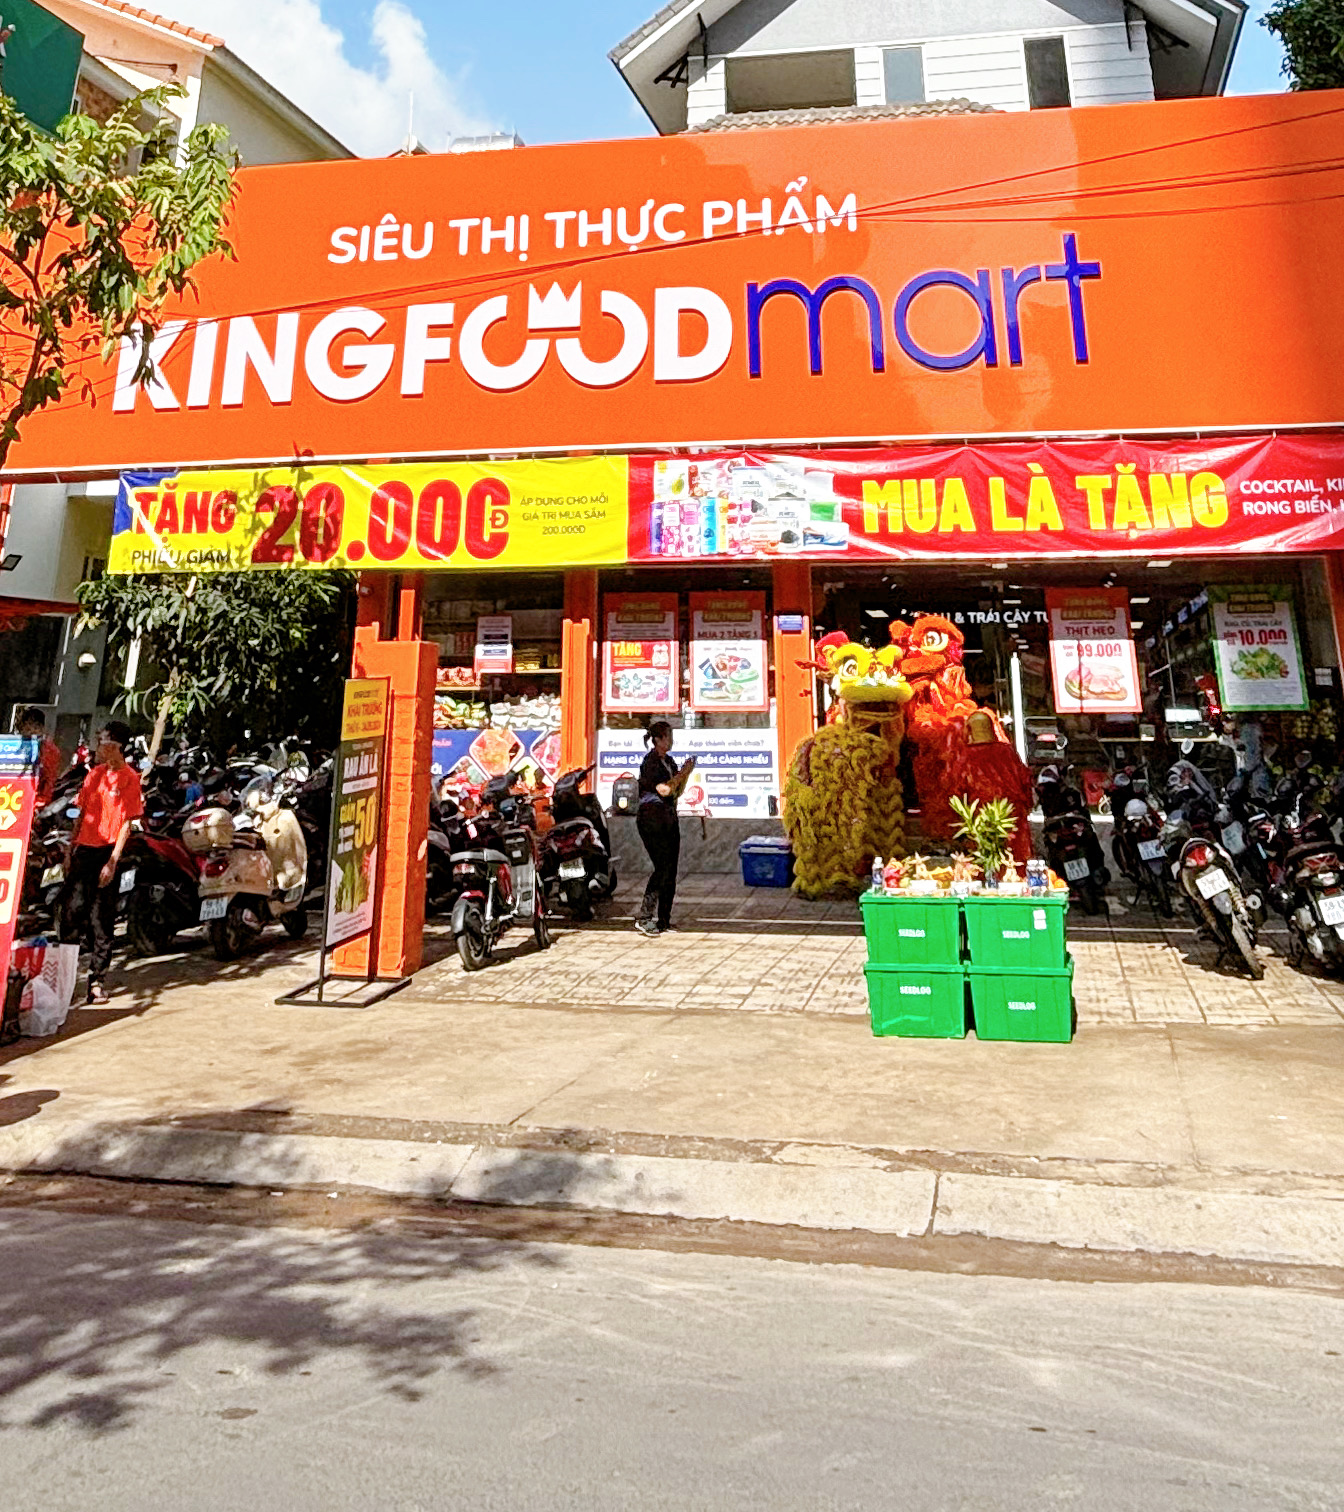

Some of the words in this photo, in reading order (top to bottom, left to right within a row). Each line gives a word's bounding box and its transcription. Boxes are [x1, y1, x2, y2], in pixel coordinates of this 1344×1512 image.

[327, 213, 433, 264] SIÊU
[449, 214, 529, 262] THỊ
[544, 199, 686, 252] THỰC
[703, 176, 857, 239] PHẨM
[862, 478, 964, 534] MUA
[990, 463, 1064, 532] LÀ
[1075, 464, 1229, 539] TẶNG
[1240, 478, 1324, 495] COCKTAIL,
[1242, 500, 1291, 516] RONG
